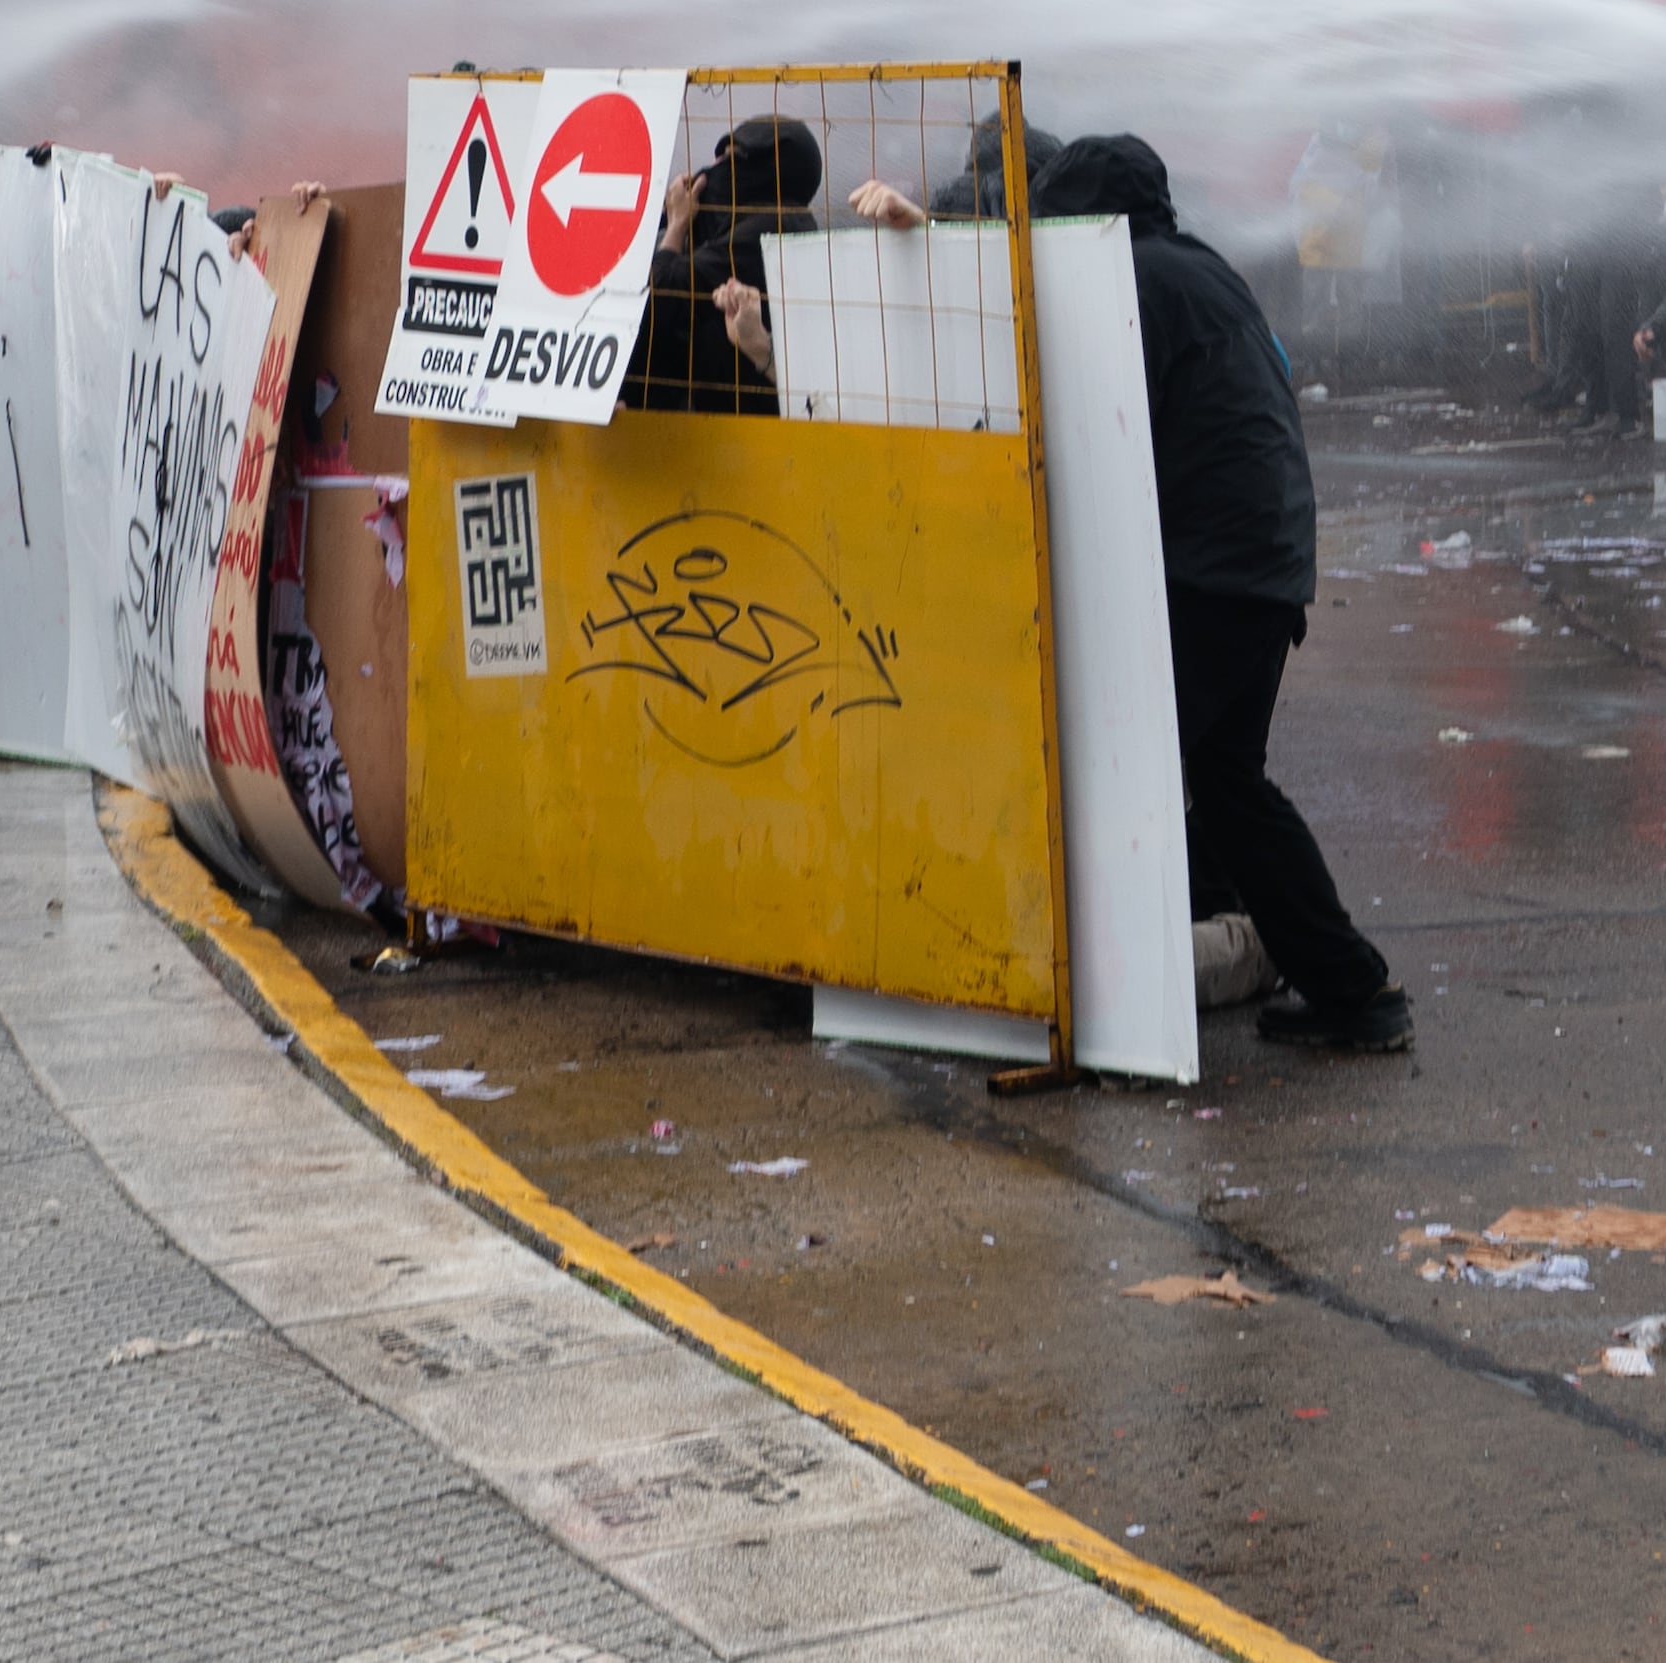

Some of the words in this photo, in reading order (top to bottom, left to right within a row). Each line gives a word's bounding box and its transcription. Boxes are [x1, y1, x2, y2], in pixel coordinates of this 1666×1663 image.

[139, 184, 223, 366] LAS
[421, 347, 463, 375] OBRA
[484, 325, 620, 392] DESVIO
[120, 347, 238, 569] MALVINAS
[127, 516, 184, 661] SON
